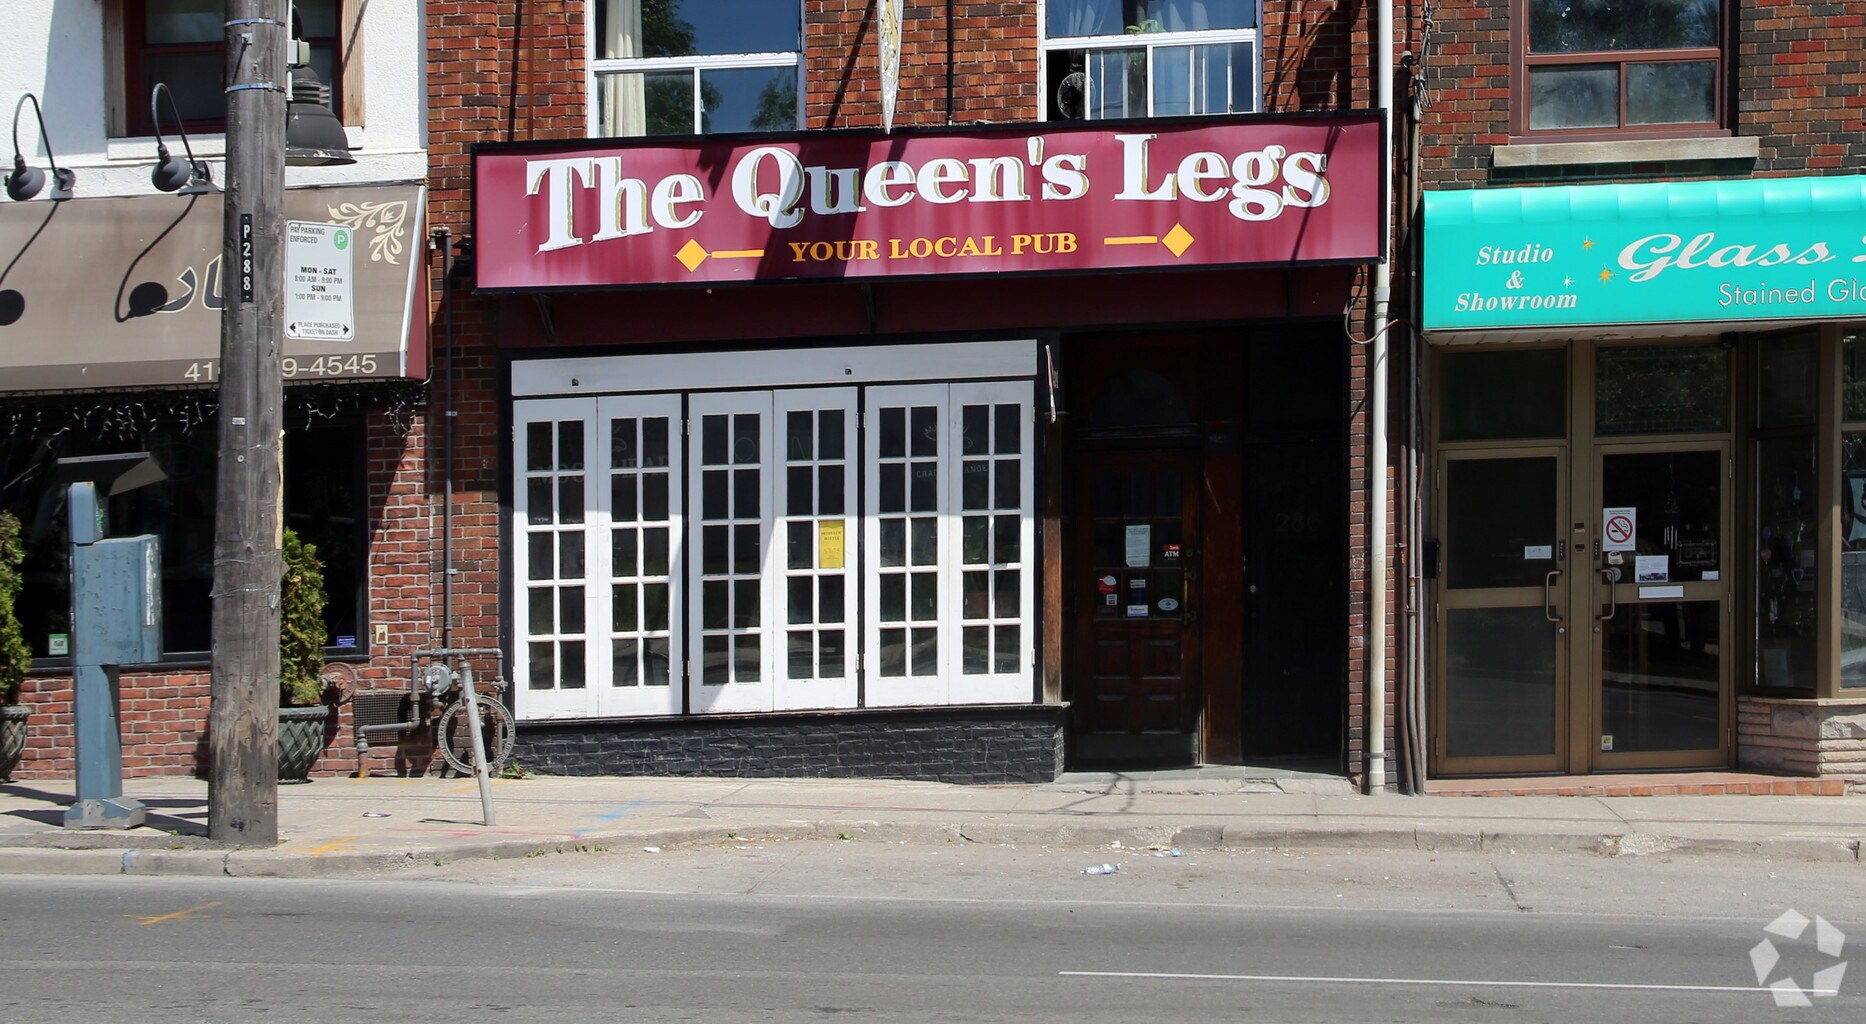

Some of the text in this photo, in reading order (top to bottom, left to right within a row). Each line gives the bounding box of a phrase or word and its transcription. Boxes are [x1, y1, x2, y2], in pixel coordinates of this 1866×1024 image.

[525, 133, 1332, 253] The Queen's Legs
[289, 235, 318, 244] ENFORCED
[290, 226, 325, 235] PAY PARKING
[243, 224, 251, 291] P288
[788, 233, 1078, 262] YOUR LOCAL PUB
[1476, 243, 1554, 266] Studio
[1617, 232, 1837, 283] Glass
[300, 266, 317, 274] MON
[323, 267, 337, 275] SAT
[321, 276, 332, 284] 9:00
[1505, 270, 1526, 289] &
[295, 293, 305, 301] 1:00
[306, 293, 316, 301] PM
[333, 294, 342, 302] PM
[1454, 291, 1578, 313] Showroom
[1718, 279, 1816, 308] Stained
